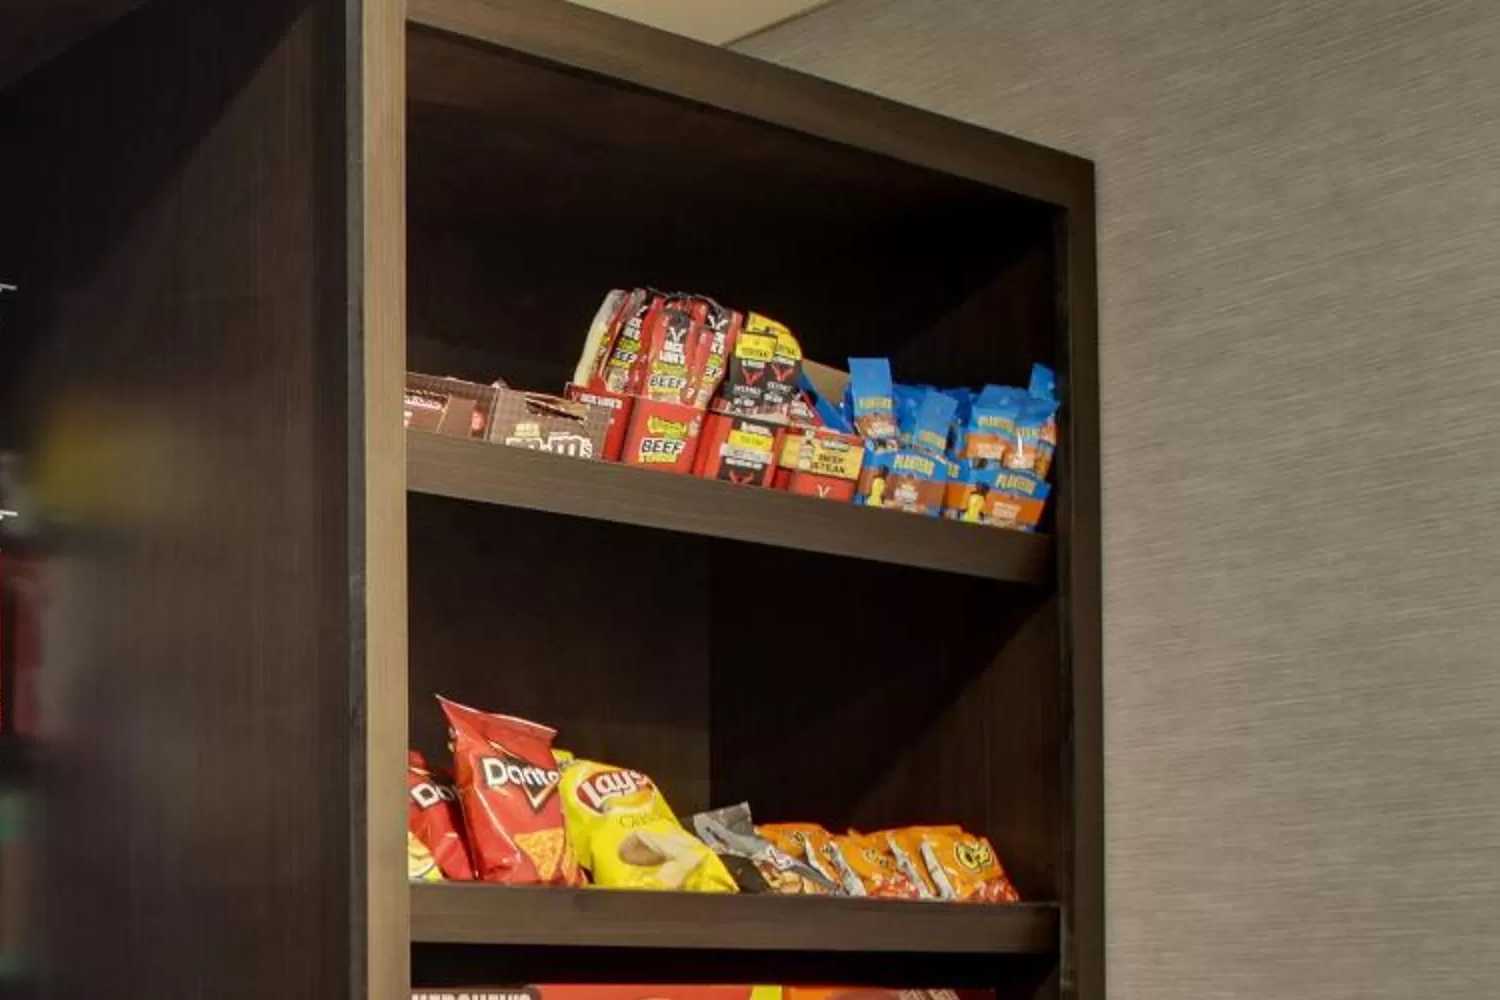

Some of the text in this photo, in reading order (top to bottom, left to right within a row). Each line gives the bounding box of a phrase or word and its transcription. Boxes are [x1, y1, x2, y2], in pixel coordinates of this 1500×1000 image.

[640, 438, 686, 456] BEEF
[483, 757, 559, 788] Dorito
[411, 783, 455, 809] Do
